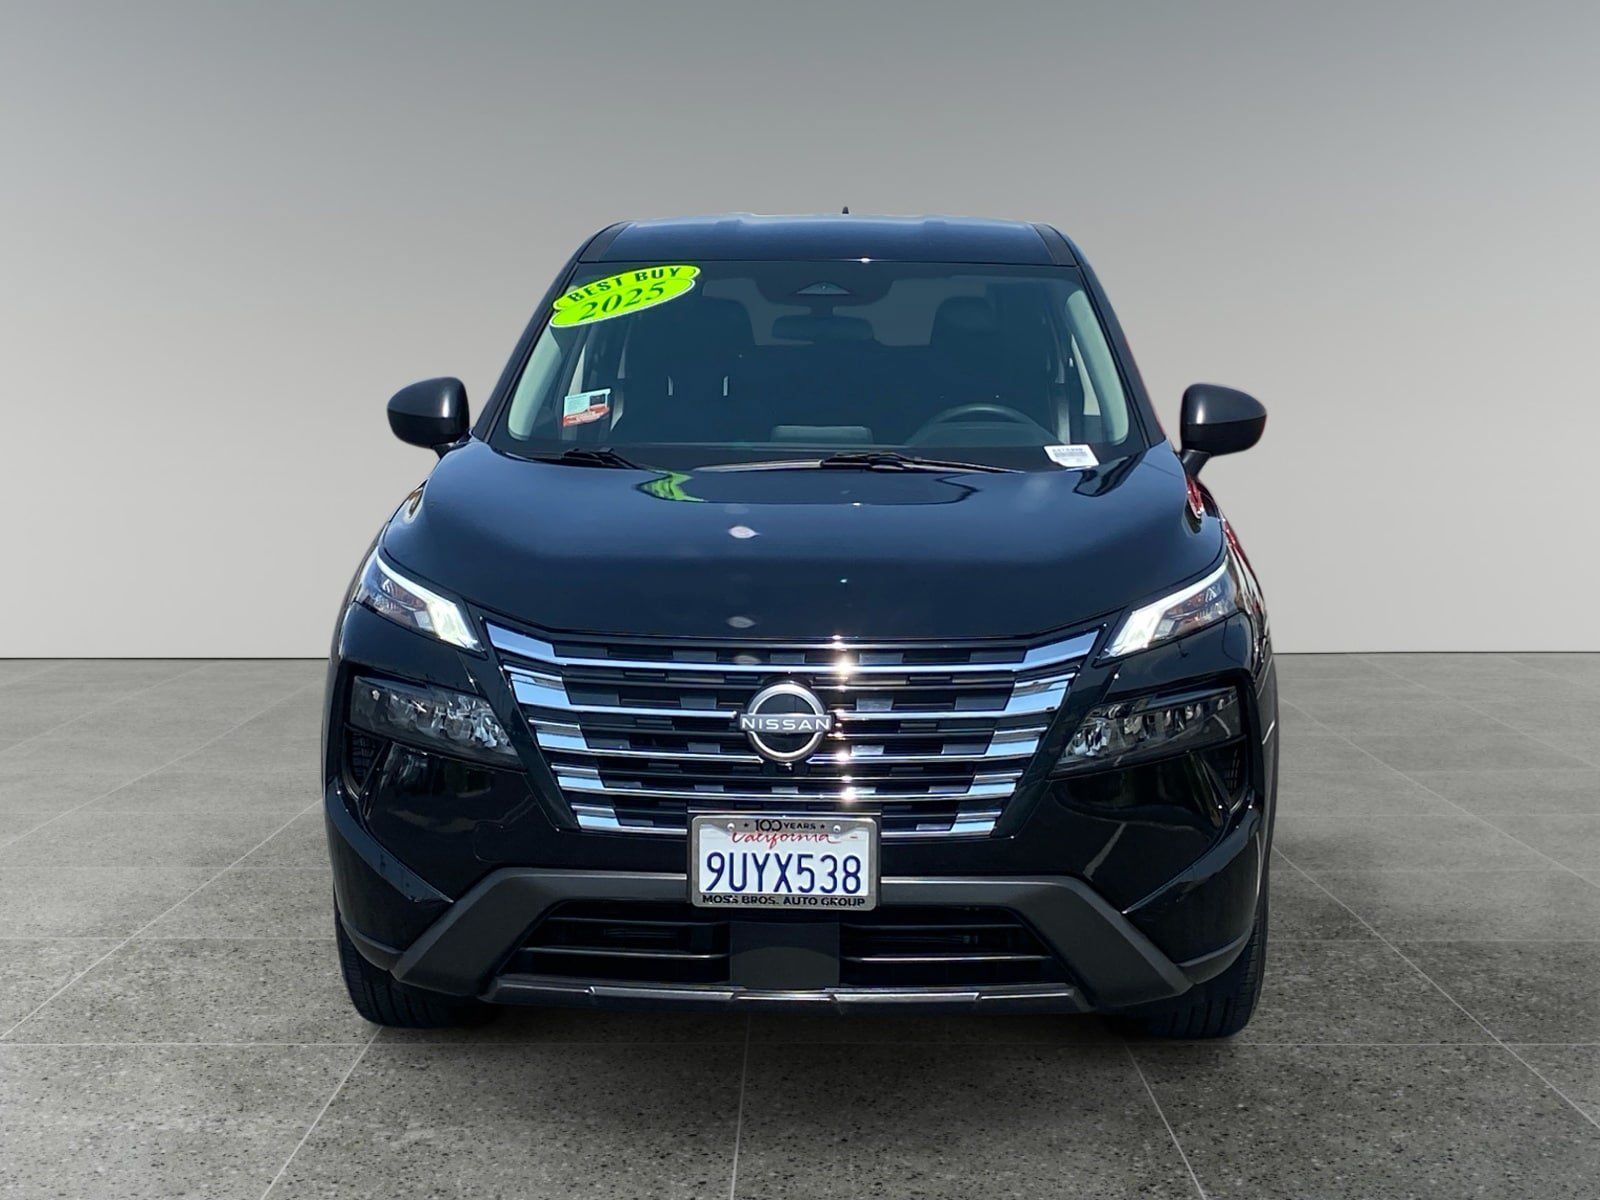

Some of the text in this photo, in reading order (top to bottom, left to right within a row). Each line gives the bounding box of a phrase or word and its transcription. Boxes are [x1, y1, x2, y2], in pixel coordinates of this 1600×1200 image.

[567, 267, 681, 302] BEST BUY
[578, 281, 666, 321] 2025
[741, 718, 830, 730] NISSAN
[755, 819, 816, 832] 100 YEARS
[705, 851, 861, 894] 9UYX538
[702, 894, 866, 907] MOSS BROS. AUTO GROUP
